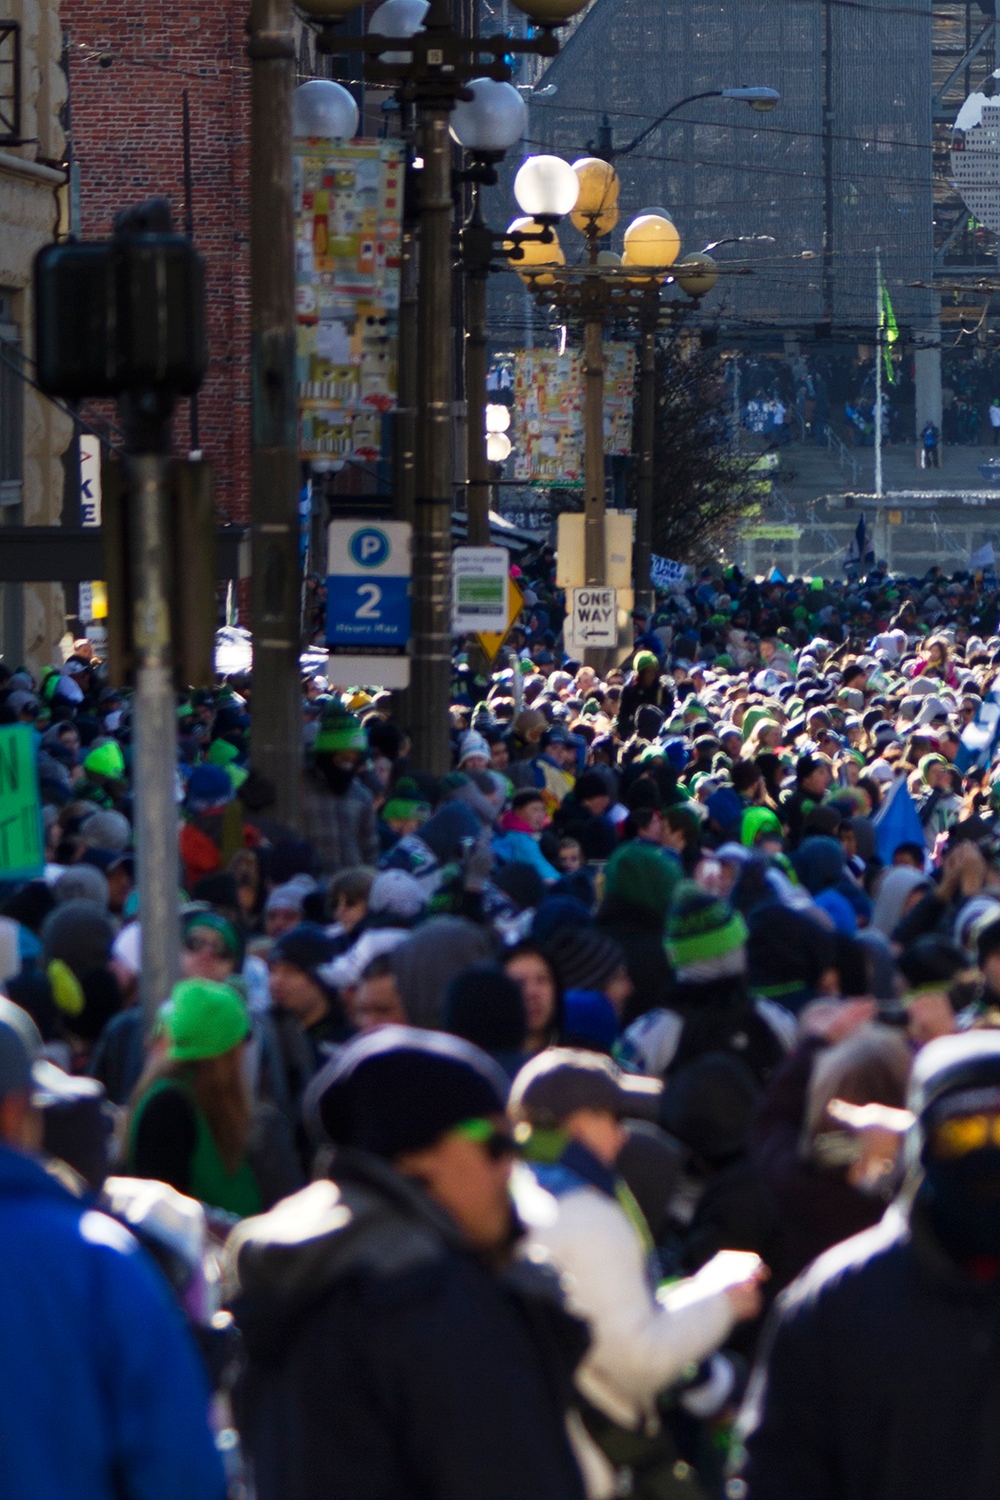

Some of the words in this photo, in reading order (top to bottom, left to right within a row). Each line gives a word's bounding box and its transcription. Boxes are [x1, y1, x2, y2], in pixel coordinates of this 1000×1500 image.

[361, 535, 381, 560] P
[355, 583, 382, 618] 2
[578, 592, 611, 606] ONE
[578, 608, 612, 622] WAY
